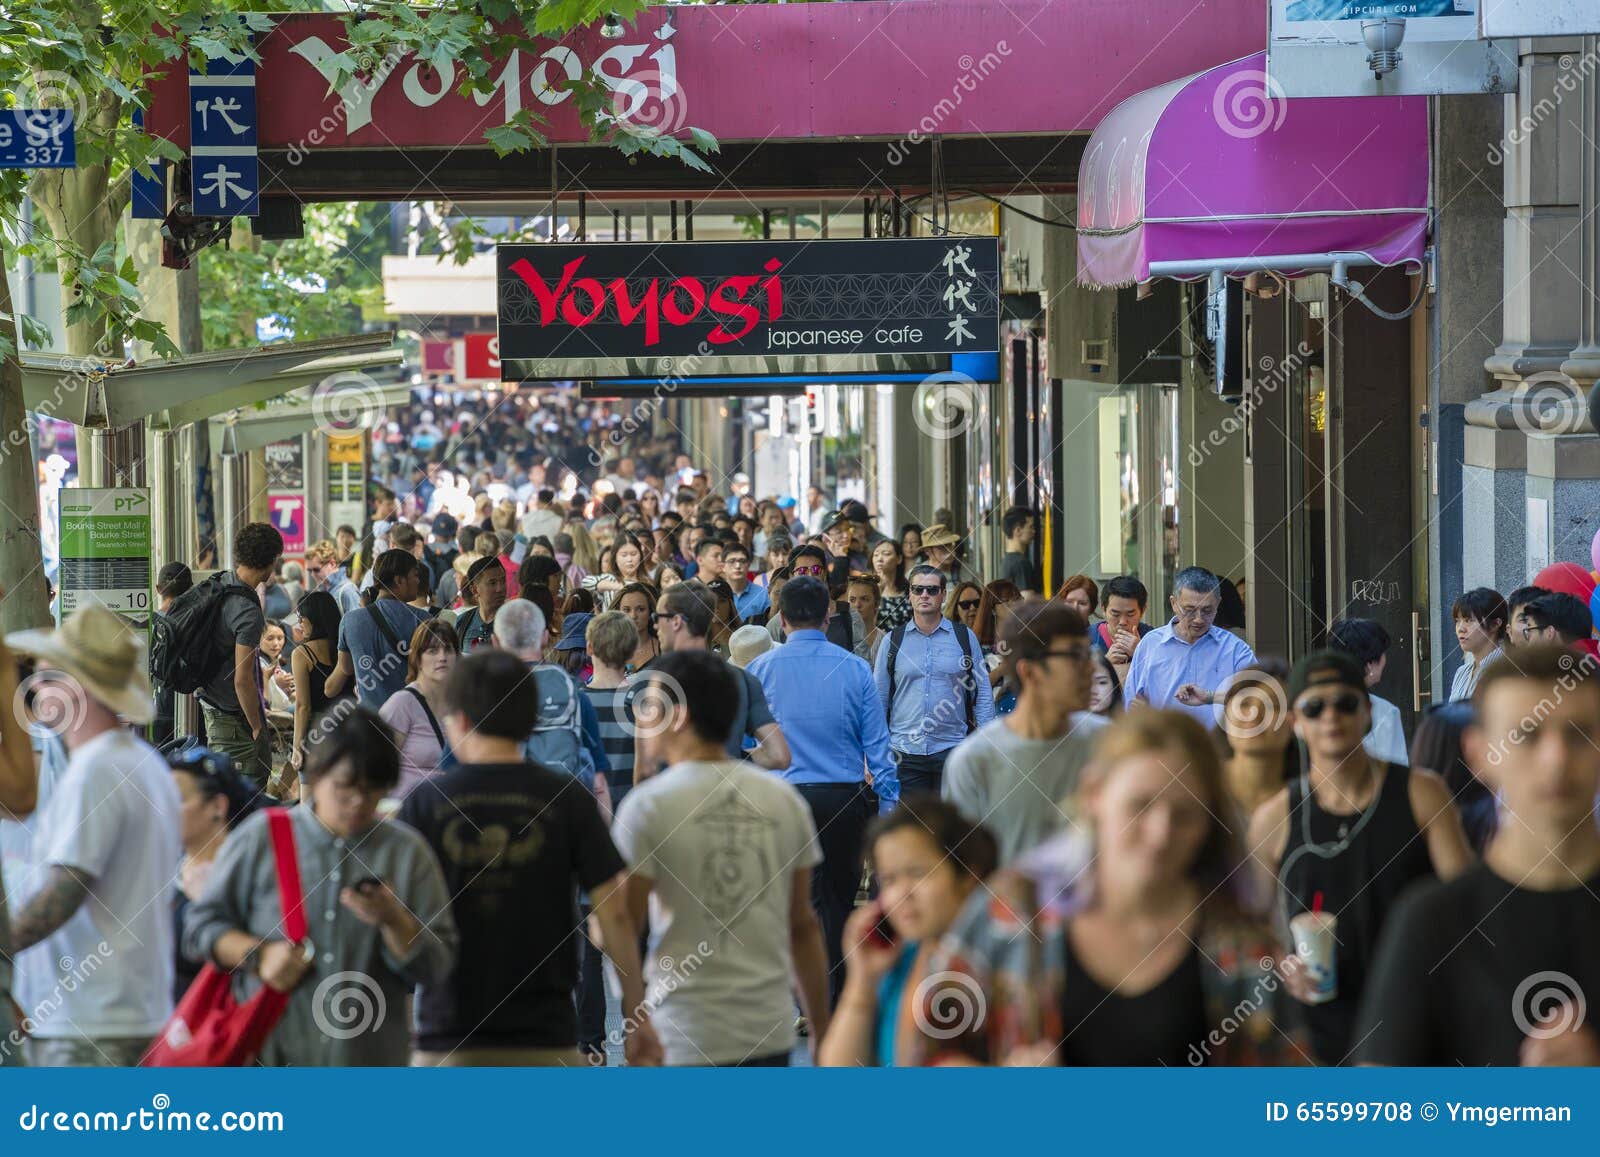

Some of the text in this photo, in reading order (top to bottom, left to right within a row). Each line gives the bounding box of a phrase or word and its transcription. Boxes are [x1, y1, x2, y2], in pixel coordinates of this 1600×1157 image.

[288, 22, 678, 136] Yoyogi
[25, 115, 64, 147] St
[24, 146, 64, 164] 337
[508, 254, 784, 347] Yoyogi
[767, 325, 923, 349] japanese cafe
[115, 498, 134, 511] PT
[65, 521, 94, 530] Bourke
[97, 521, 121, 530] Street
[124, 521, 141, 530] Mall
[90, 531, 146, 539] Bourke Street
[126, 592, 147, 608] 10
